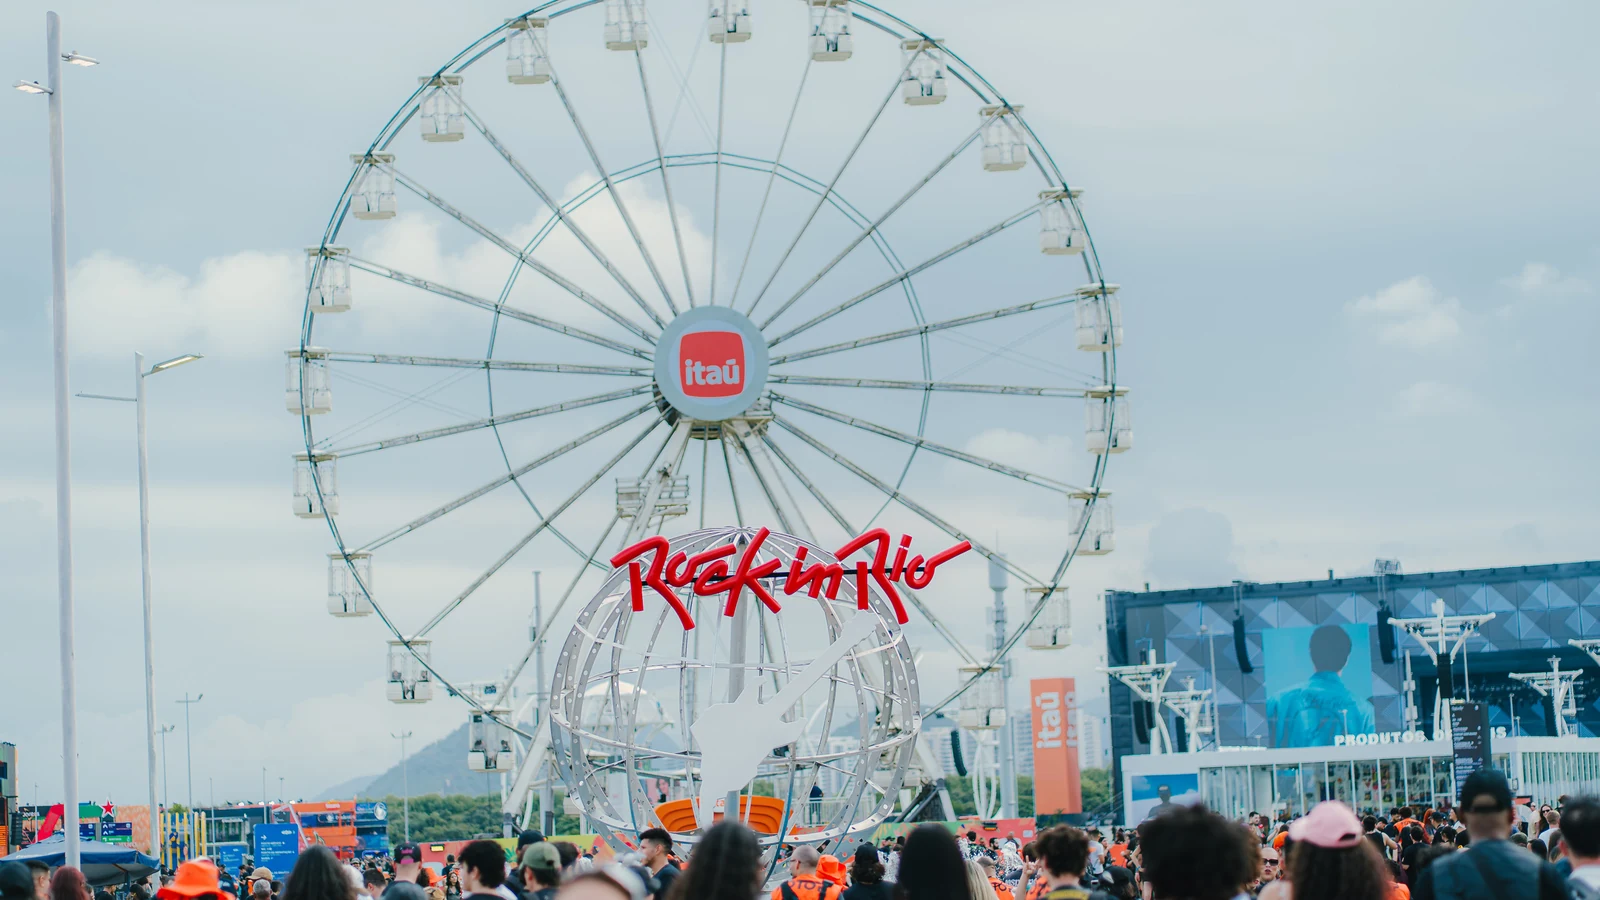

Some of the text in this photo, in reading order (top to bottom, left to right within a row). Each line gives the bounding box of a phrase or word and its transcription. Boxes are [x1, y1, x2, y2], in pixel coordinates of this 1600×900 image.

[685, 358, 740, 386] itaú
[610, 526, 972, 630] Rock in Rio
[1034, 691, 1062, 748] itaú
[1334, 730, 1426, 747] PRODUTOS
